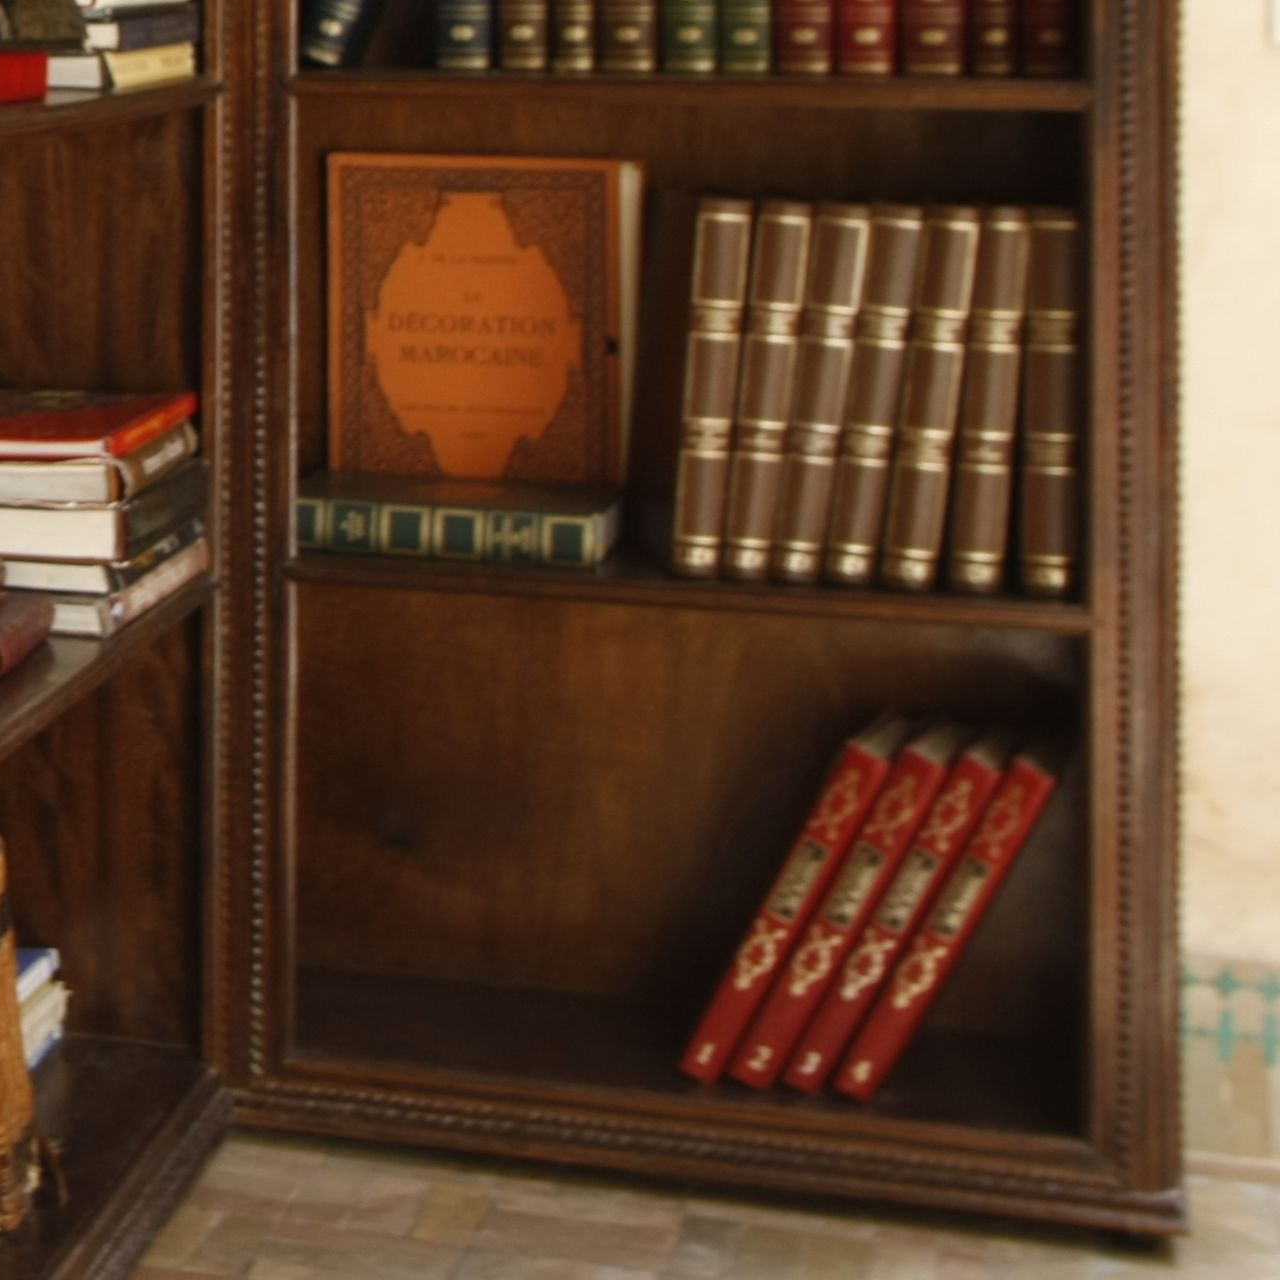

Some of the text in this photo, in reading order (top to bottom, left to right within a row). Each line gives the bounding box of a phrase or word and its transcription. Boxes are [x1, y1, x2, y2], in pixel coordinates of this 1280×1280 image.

[401, 345, 542, 367] MAROCAINE
[745, 1044, 773, 1071] 2
[796, 1050, 823, 1075] 3
